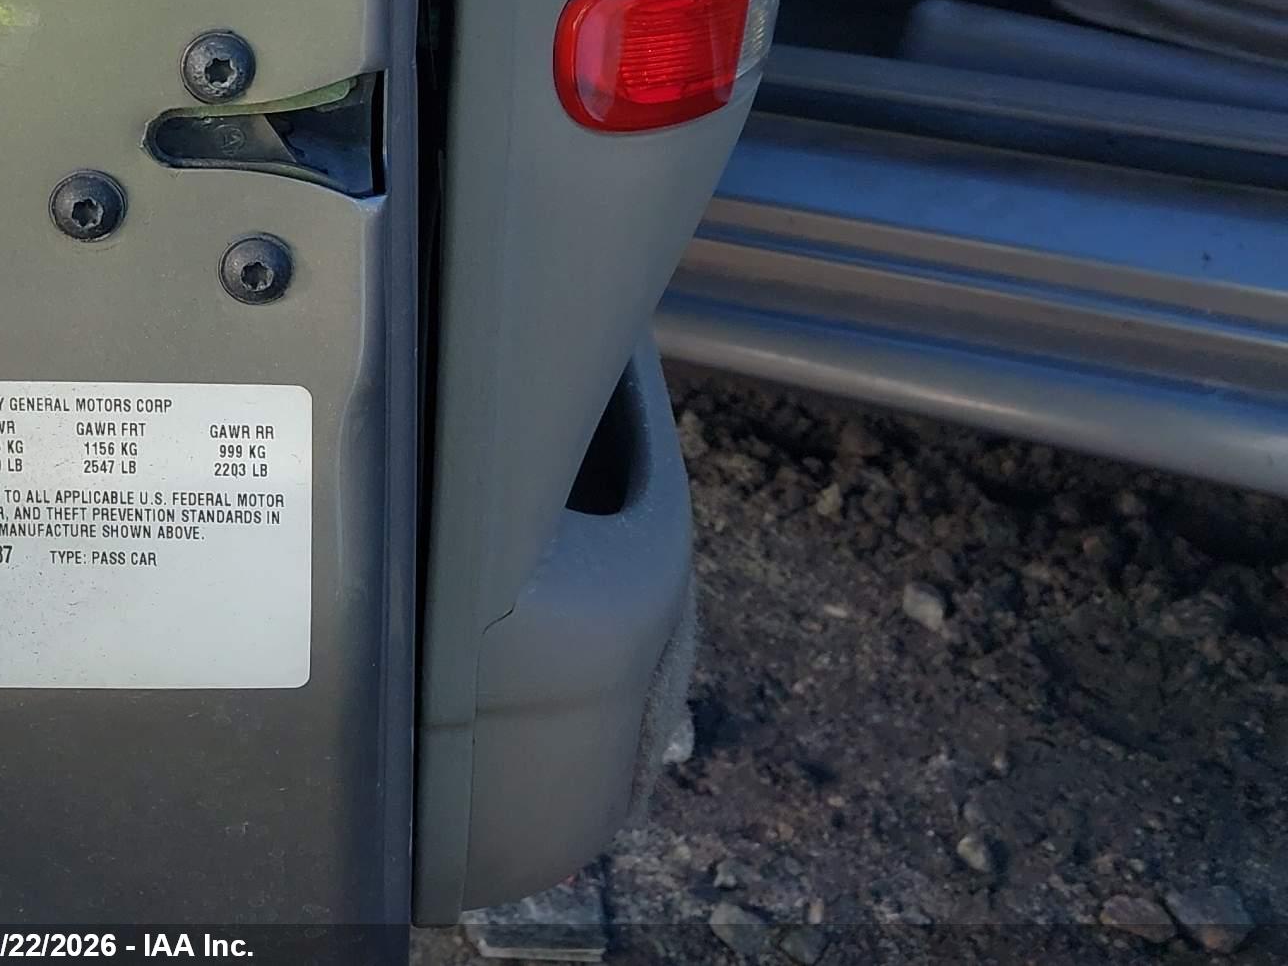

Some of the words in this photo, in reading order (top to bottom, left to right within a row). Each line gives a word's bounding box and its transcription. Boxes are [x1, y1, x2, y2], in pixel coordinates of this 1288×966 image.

[10, 396, 70, 411] GENERAL
[76, 398, 131, 412] MOTORS
[137, 399, 172, 413] CORP
[77, 421, 116, 436] GAWR
[122, 422, 146, 436] FRT
[210, 425, 250, 439] GAWR
[256, 425, 274, 439] RR
[7, 440, 23, 454] KG
[84, 442, 114, 455] 1156
[121, 442, 137, 456] KG
[220, 445, 242, 458] 999
[249, 445, 265, 459] KG
[8, 458, 22, 472] LB
[84, 460, 114, 474] 2547
[119, 460, 136, 474] LB
[214, 463, 246, 477] 2203
[253, 463, 267, 477] LB
[4, 490, 20, 503] TO
[26, 490, 50, 504] ALL
[55, 490, 134, 505] APPLICABLE
[140, 491, 166, 505] U.S.
[173, 492, 231, 506] FEDERAL
[238, 493, 284, 507] MOTOR
[14, 504, 40, 520] AND
[46, 507, 87, 521] THEFT
[93, 508, 174, 522] PREVENTION
[182, 509, 261, 524] STANDARDS
[267, 511, 279, 524] IN
[0, 523, 96, 537] MANUFACTURE
[102, 524, 151, 538] SHOWN
[158, 526, 204, 539] ABOVE.
[50, 551, 86, 564] TYPE:
[92, 551, 125, 565] PASS
[131, 552, 157, 566] CAR
